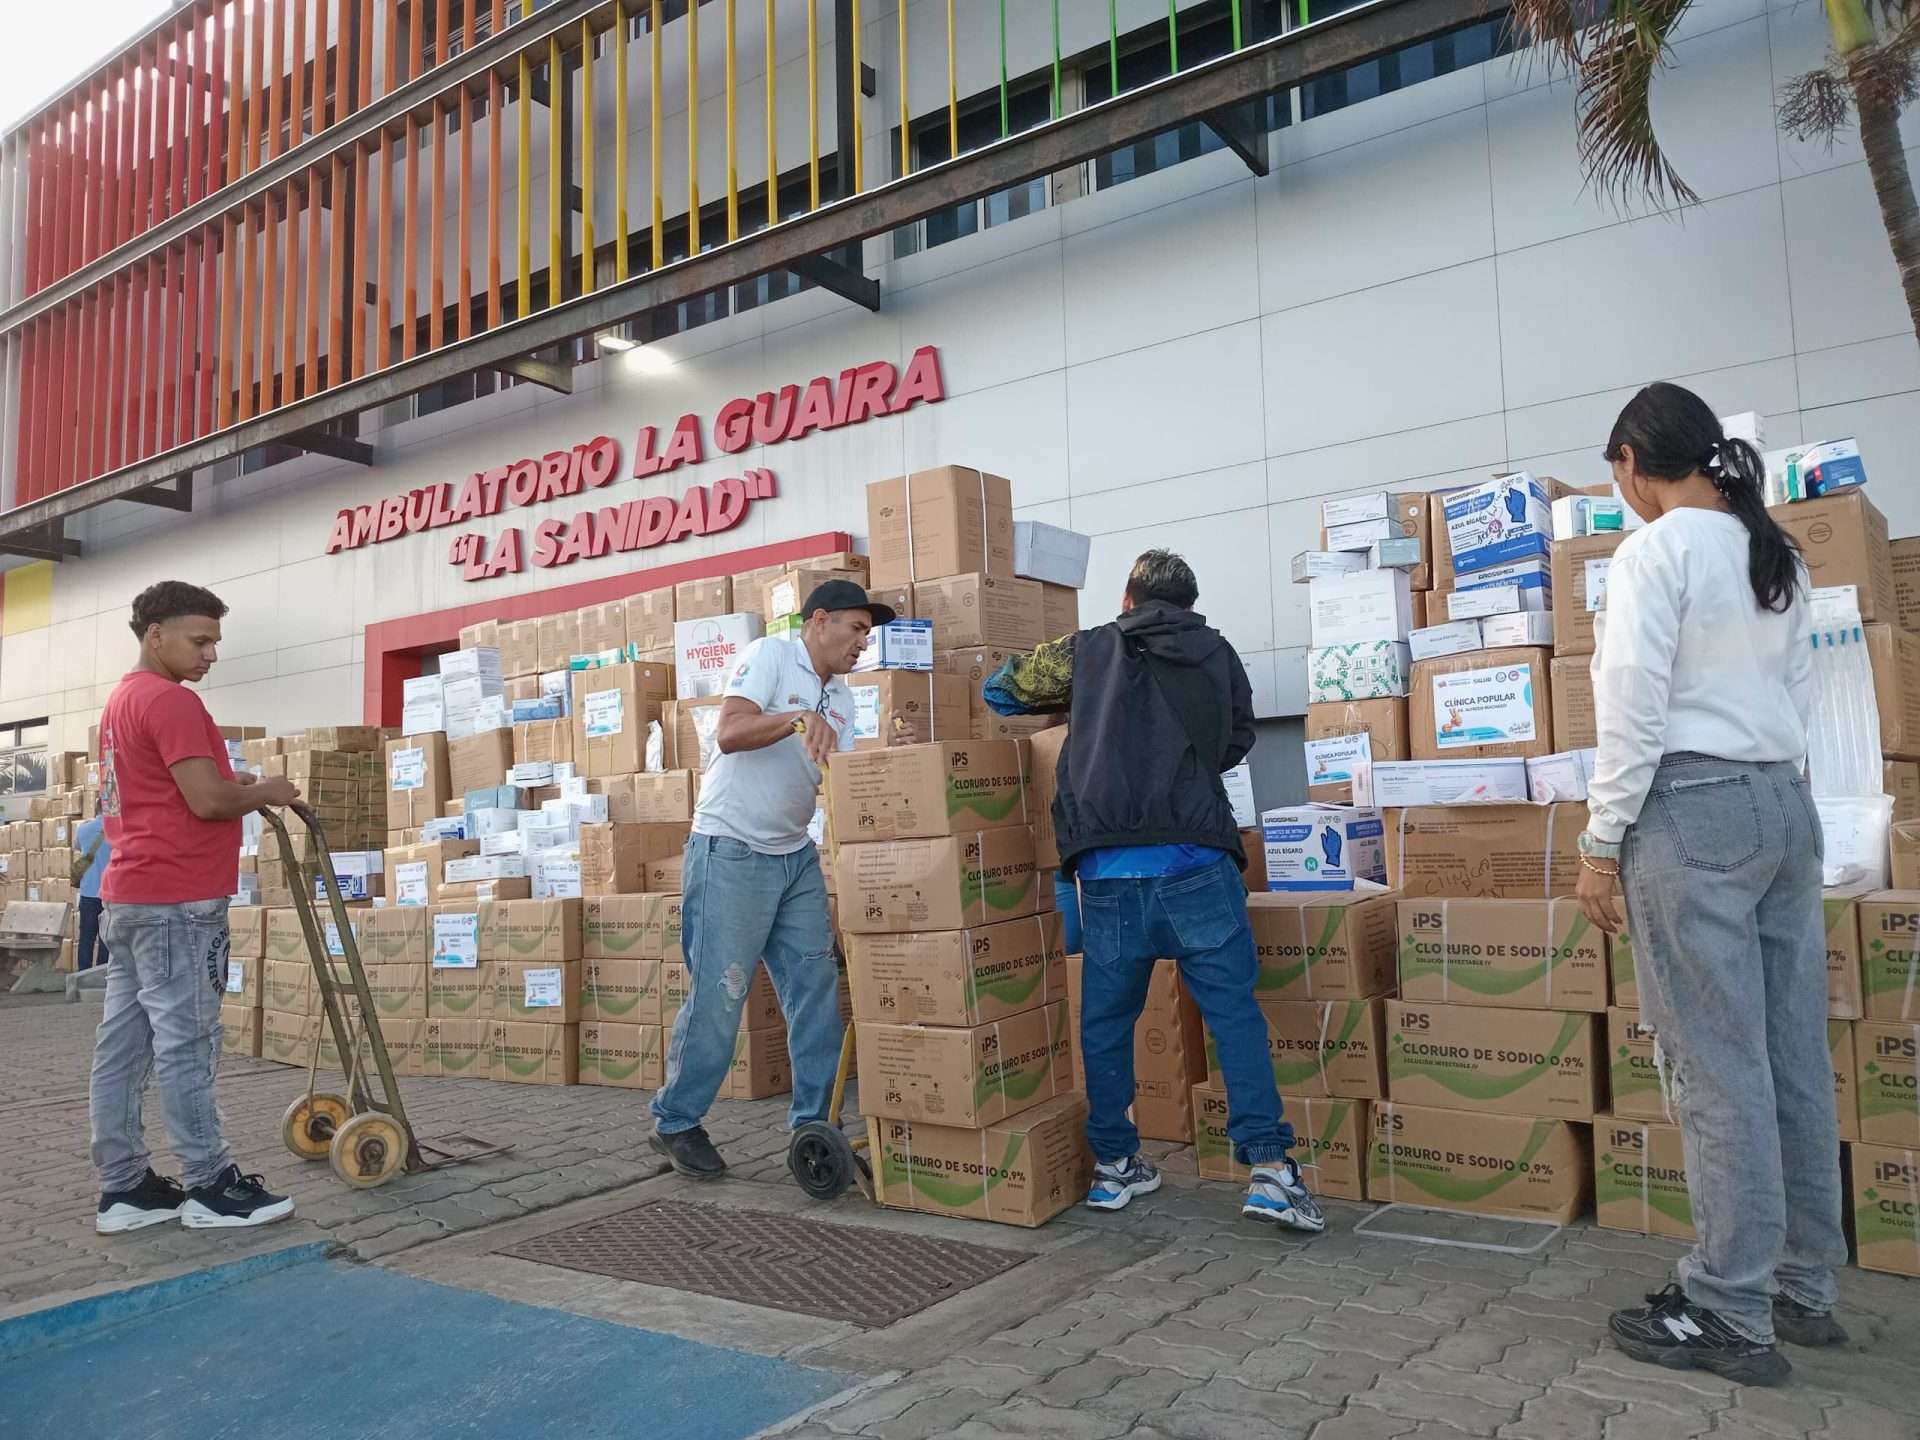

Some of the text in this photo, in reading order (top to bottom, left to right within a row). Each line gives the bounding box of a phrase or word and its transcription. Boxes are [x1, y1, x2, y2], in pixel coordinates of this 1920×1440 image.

[325, 345, 946, 555] AMBULATORIO LA GUAIRA
[686, 643, 737, 660] HYGIENE
[699, 656, 725, 670] KITS
[1444, 692, 1516, 708] CLÍNICA POPULAR
[952, 752, 969, 766] iPS
[955, 777, 991, 790] CLORURO
[992, 777, 1002, 786] DE
[858, 815, 875, 826] iPS
[965, 842, 980, 857] iPS
[968, 868, 1002, 881] CLORURO
[1004, 865, 1013, 876] DE
[1307, 860, 1317, 871] M
[865, 906, 883, 918] iPS
[1412, 912, 1442, 928] iPS
[1881, 912, 1920, 932] iPS
[973, 937, 991, 954] iPS
[1257, 945, 1347, 958] DE SODIO 0,9%
[1416, 942, 1598, 960] CLORURO DE SODIO 0,9%
[975, 961, 1012, 978] CLORURO
[1014, 958, 1023, 968] DE
[880, 996, 895, 1008] iPS
[1400, 1012, 1430, 1029] iPS
[982, 1034, 998, 1053] iPS
[1277, 1039, 1294, 1049] DE
[1298, 1040, 1335, 1050] SODIO
[1339, 1040, 1368, 1051] 0,9%
[1876, 1036, 1916, 1056] iPS
[1020, 1052, 1031, 1064] DE
[1402, 1043, 1584, 1069] CLORURO DE SODIO 0,9%
[885, 1092, 902, 1103] iPS
[1203, 1099, 1227, 1114] iPS
[1376, 1112, 1404, 1130] iPS
[890, 1125, 913, 1142] iPS
[1610, 1130, 1644, 1149] iPS
[1323, 1139, 1350, 1153] 0,9%
[893, 1152, 1026, 1182] CLORURO DE SODIO 0,9%
[1378, 1142, 1554, 1176] CLORURO DE SODIO 0,9%
[1875, 1161, 1918, 1184] iPS
